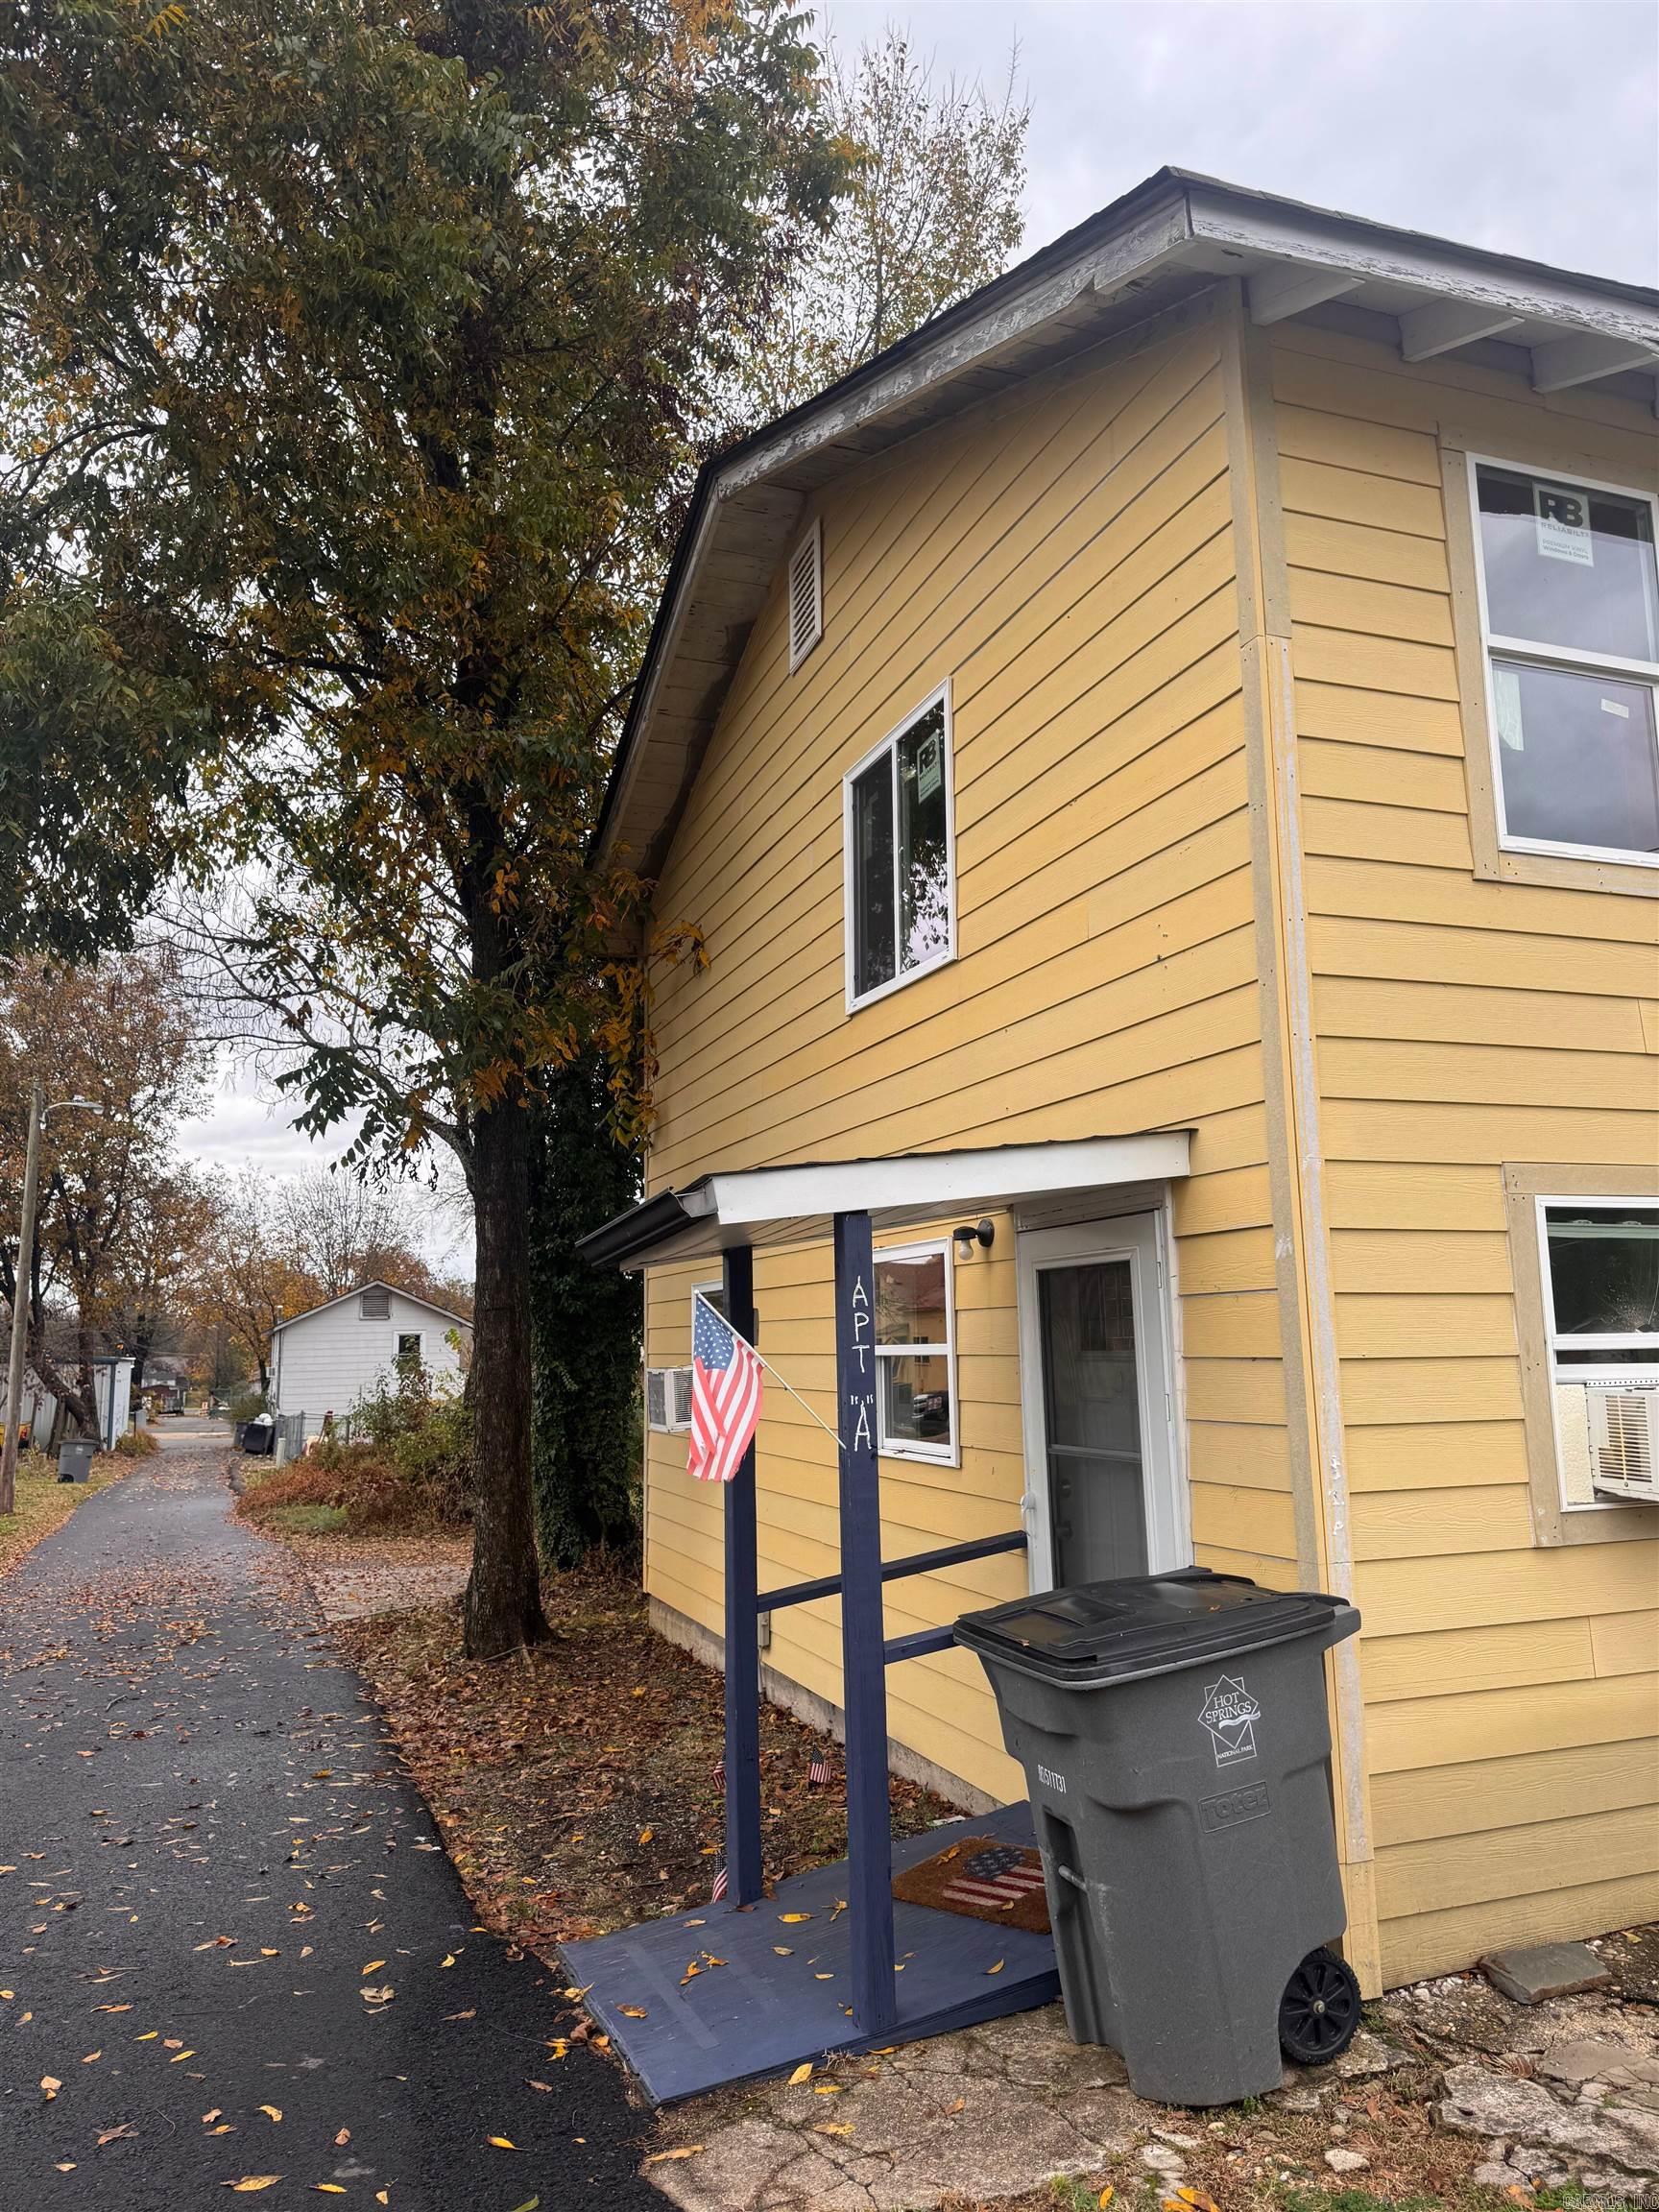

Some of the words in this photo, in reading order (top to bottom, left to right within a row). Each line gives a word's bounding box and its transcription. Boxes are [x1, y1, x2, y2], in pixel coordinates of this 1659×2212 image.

[1539, 490, 1584, 528] RB
[852, 1275, 870, 1374] APT
[1205, 1700, 1252, 1724] SPRINGS
[1214, 1692, 1239, 1709] HOT
[1216, 1747, 1241, 1760] NATIONAL
[1240, 1743, 1253, 1753] PARK
